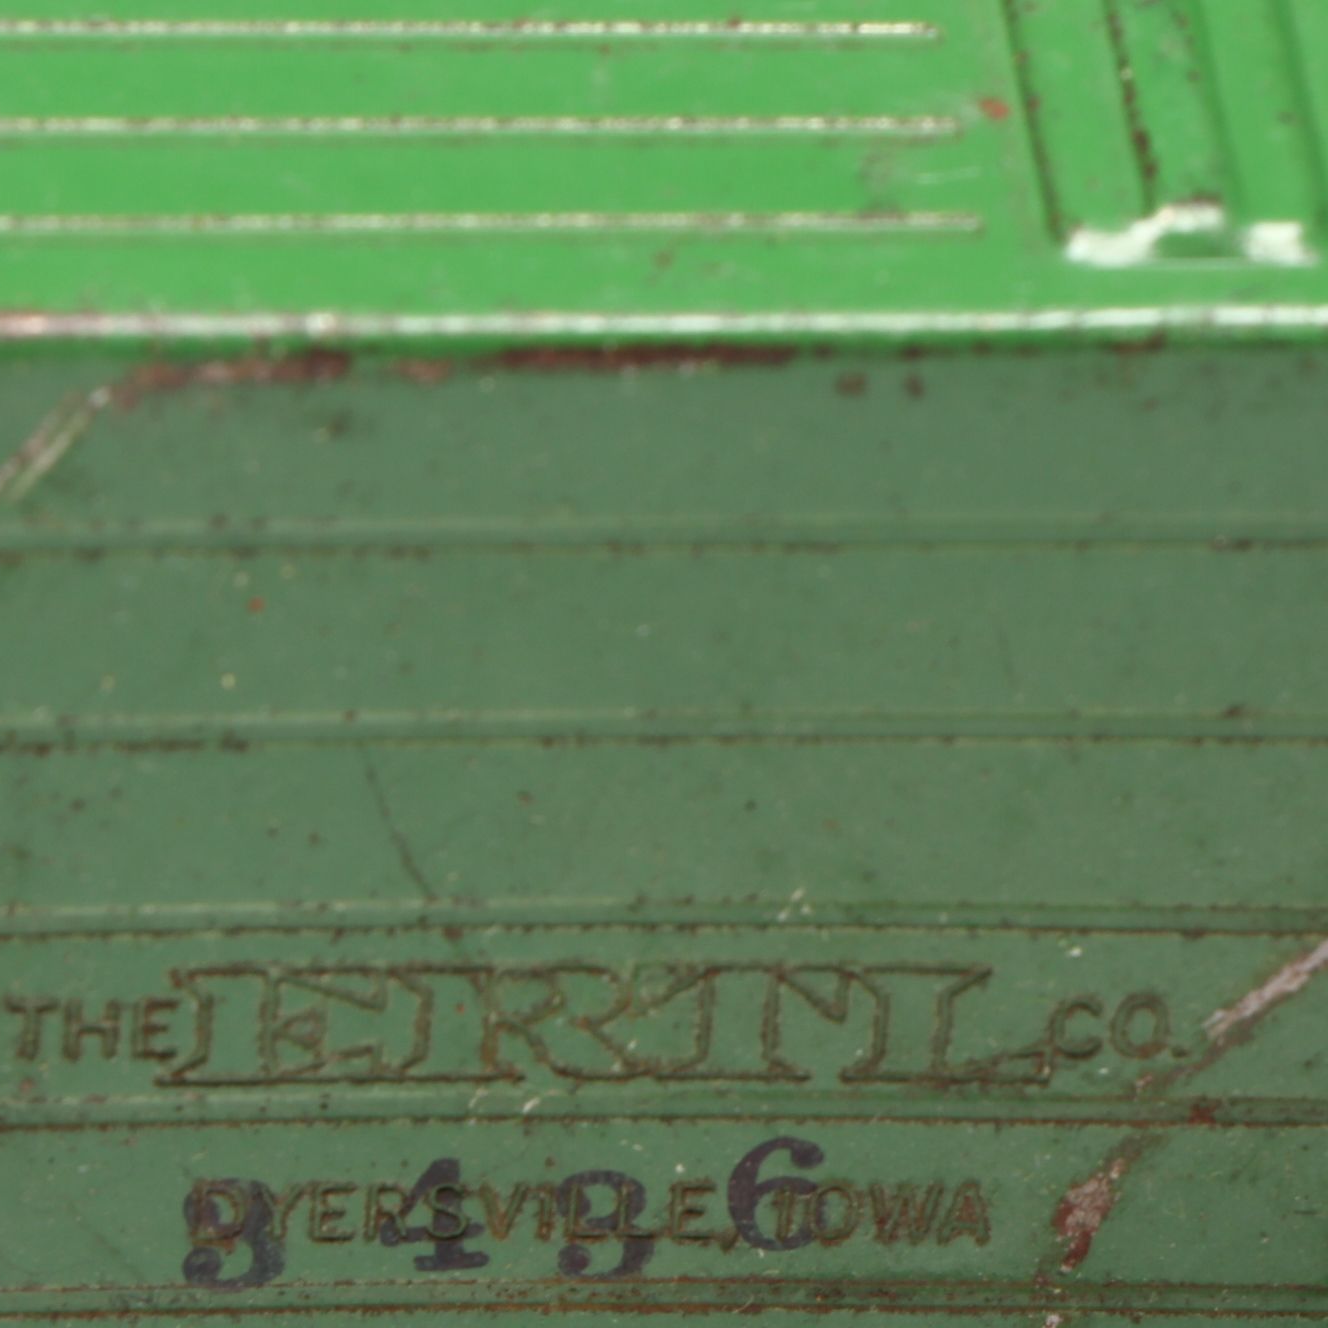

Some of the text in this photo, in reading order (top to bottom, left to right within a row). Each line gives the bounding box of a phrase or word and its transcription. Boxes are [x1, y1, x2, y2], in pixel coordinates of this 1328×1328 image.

[4, 961, 1190, 1086] THE ERTL CO.
[770, 1176, 994, 1248] IOWA
